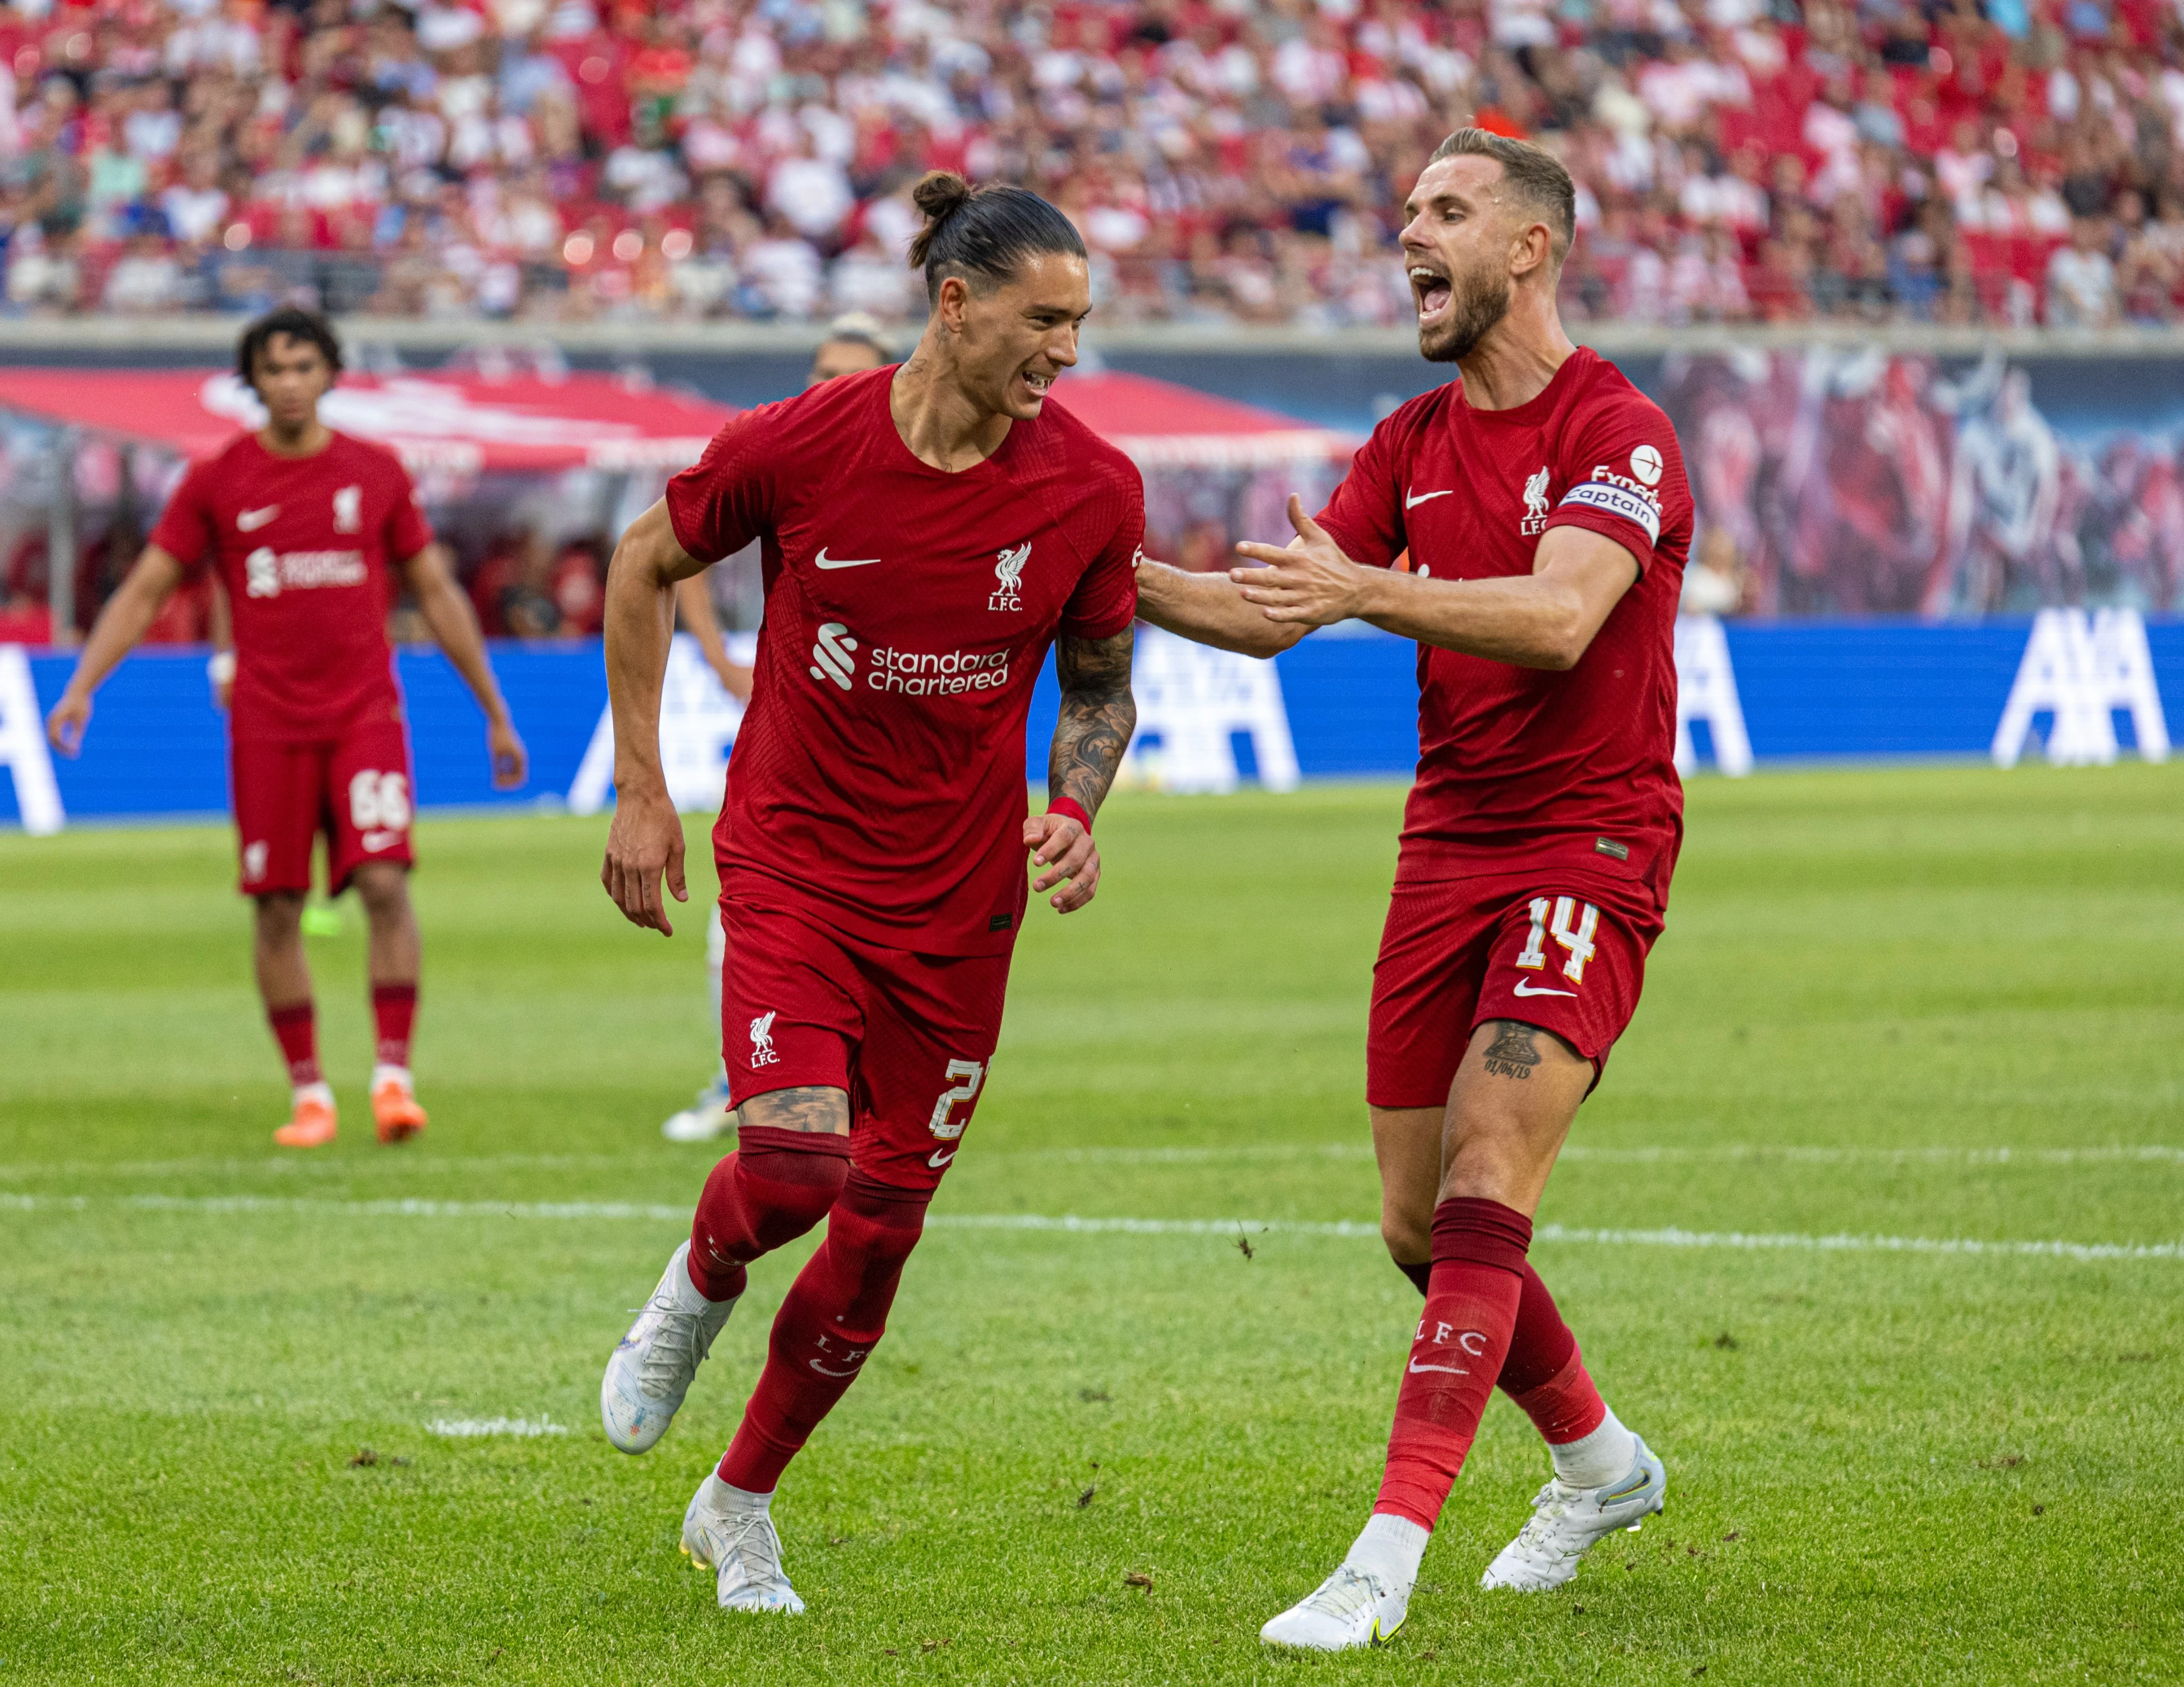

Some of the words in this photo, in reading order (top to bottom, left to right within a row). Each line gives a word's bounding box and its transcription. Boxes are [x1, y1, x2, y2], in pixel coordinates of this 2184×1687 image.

[871, 646, 1010, 674] standard
[868, 663, 1008, 695] chartered
[1515, 896, 1600, 985] 14
[928, 1055, 993, 1140] 2
[814, 1333, 872, 1362] LF
